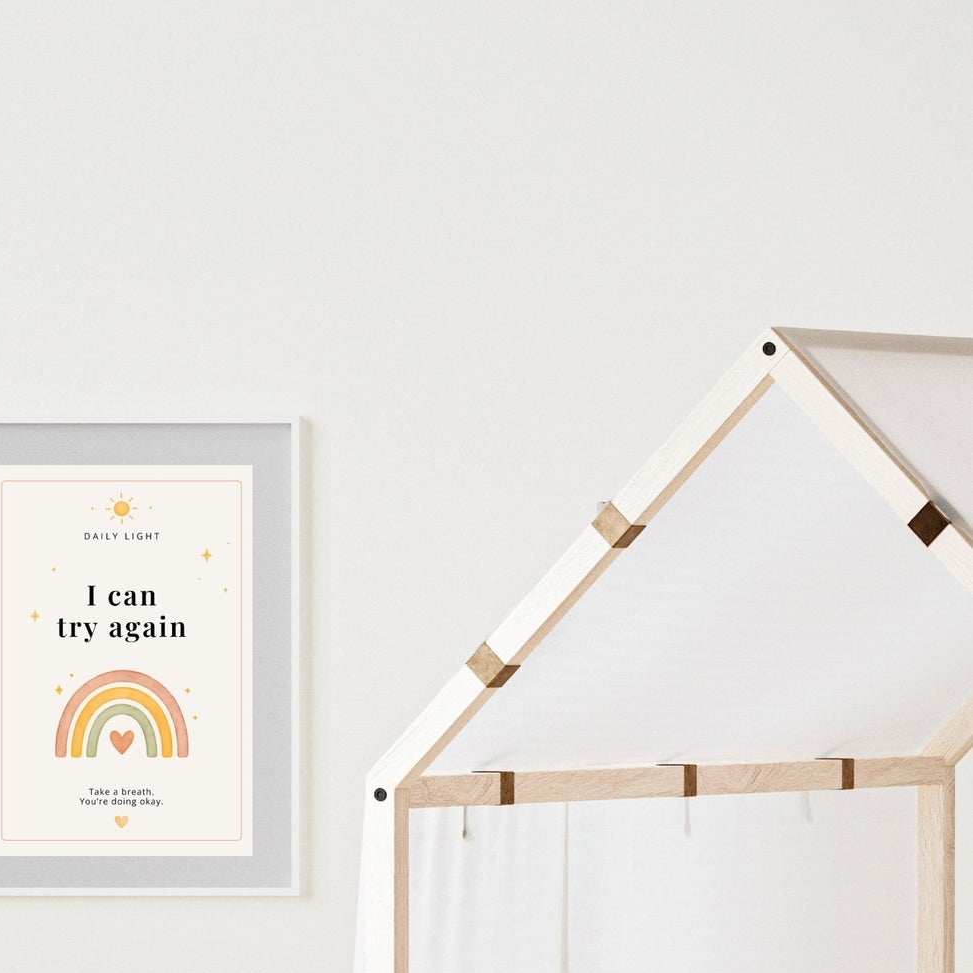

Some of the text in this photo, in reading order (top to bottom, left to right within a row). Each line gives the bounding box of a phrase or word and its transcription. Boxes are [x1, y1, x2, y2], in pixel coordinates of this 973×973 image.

[83, 532, 160, 541] DAILY LIGHT
[87, 585, 157, 607] I can
[56, 614, 187, 643] try again
[88, 787, 110, 796] Take
[121, 787, 154, 796] breath.
[110, 797, 137, 807] doing
[139, 797, 164, 807] okay.
